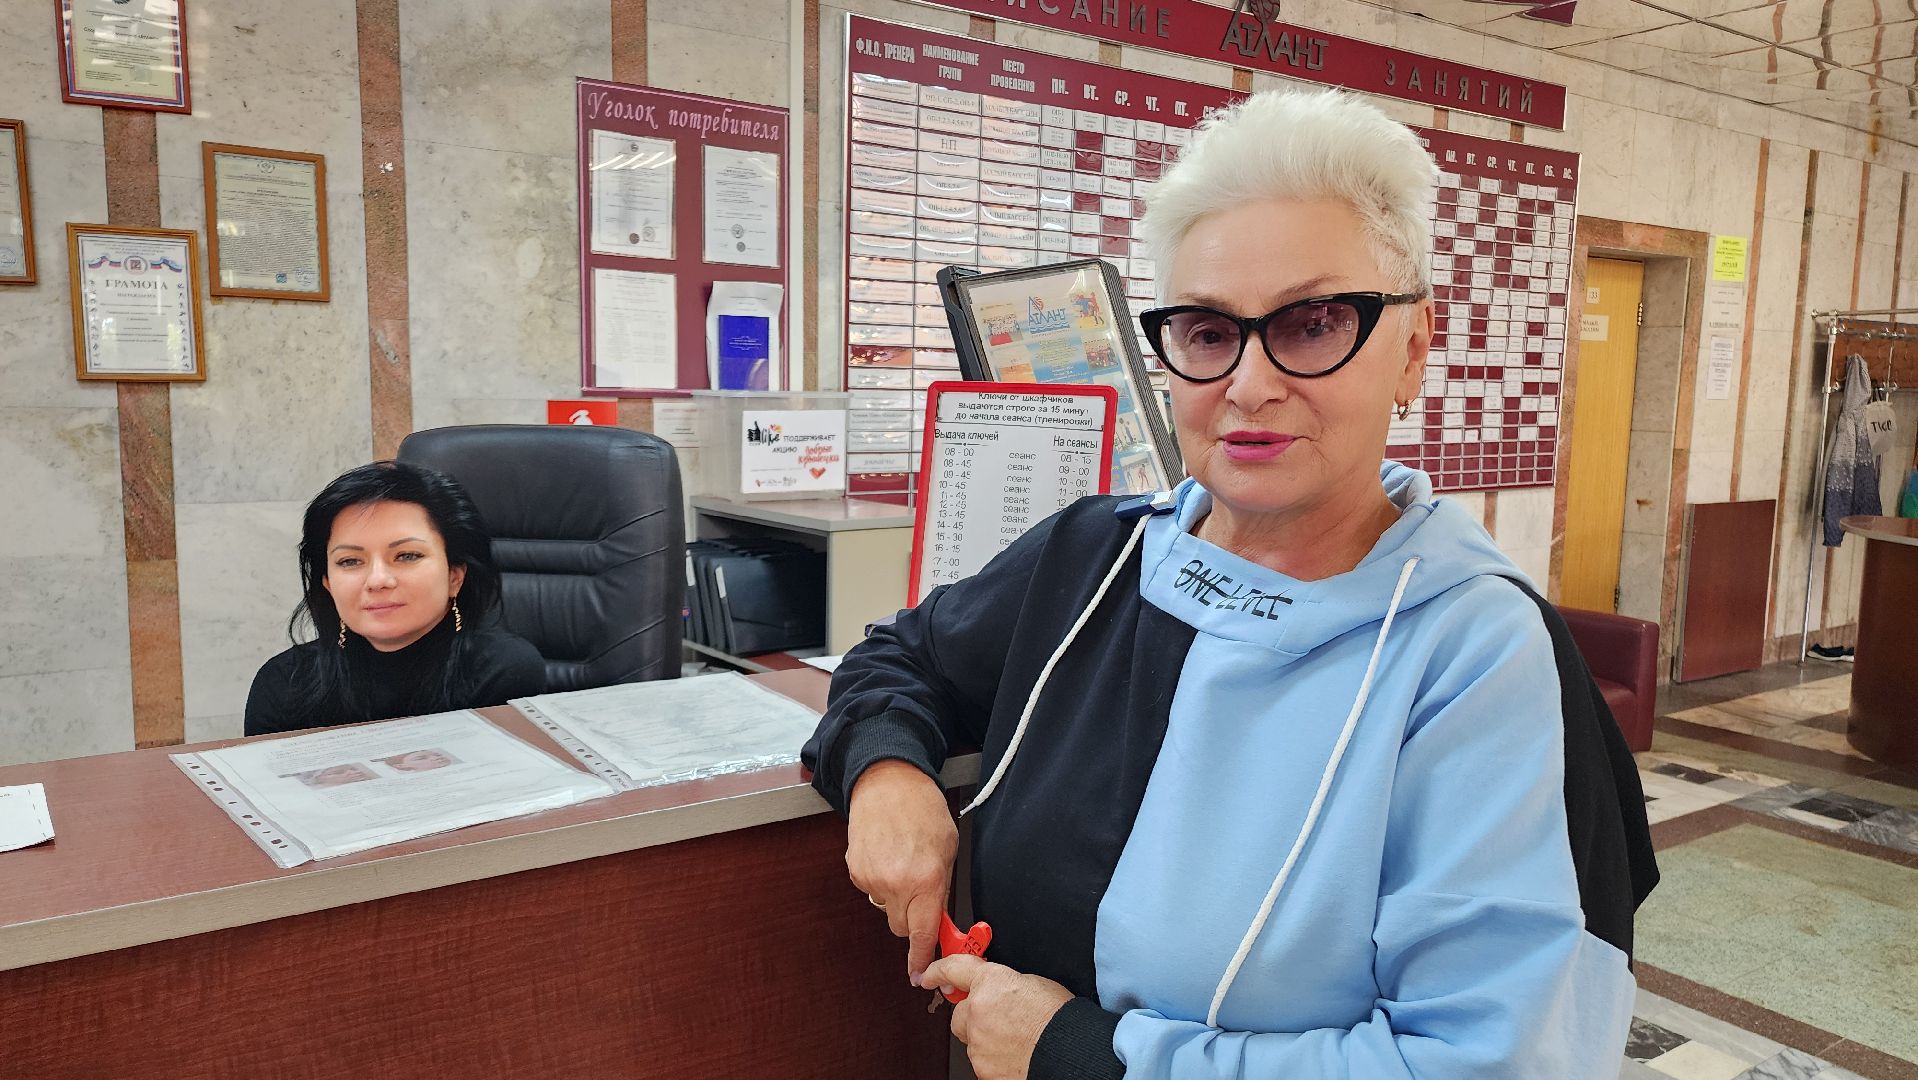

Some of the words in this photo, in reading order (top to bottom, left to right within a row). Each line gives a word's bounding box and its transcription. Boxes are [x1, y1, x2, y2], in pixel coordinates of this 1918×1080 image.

[855, 38, 882, 57] Ф.И.О.
[884, 43, 916, 63] ТРЕНЕРА
[922, 43, 980, 66] НАИМЕНОВАНИЕ
[1002, 58, 1025, 75] МЕСТО
[1220, 16, 1330, 70] АТЛАНТ
[1384, 59, 1533, 114] ЗАНЯТИЙ
[938, 64, 963, 81] ГРУПП
[990, 73, 1036, 93] ПРОВЕДЕНИЯ
[1051, 78, 1069, 95] ПН.
[1083, 83, 1099, 100] ВТ.
[1114, 90, 1131, 107] СР.
[1145, 95, 1160, 111] ЧТ.
[1174, 100, 1189, 117] ПТ.
[588, 92, 659, 130] Уголок
[668, 108, 780, 140] потребителя
[1466, 153, 1476, 165] ВТ.
[1487, 156, 1497, 168] СР.
[1507, 159, 1517, 171] ЧТ.
[1544, 165, 1555, 177] СБ.
[105, 279, 168, 291] ГРАМОТА
[978, 392, 1007, 401] Ключи
[1022, 393, 1074, 404] шкафчиков
[958, 402, 1004, 411] выдаются
[1006, 404, 1036, 413] строго
[955, 413, 967, 421] до
[1035, 415, 1093, 427] (тренировки)
[783, 434, 836, 442] ПОДДЕРЖИВАЕТ
[935, 429, 966, 440] Выдача
[967, 431, 999, 442] ключей
[1053, 435, 1064, 447] На
[1068, 438, 1098, 449] сеансы
[772, 446, 798, 454] АКЦИЮ
[945, 448, 955, 456] 08
[965, 448, 974, 456] 00
[1060, 454, 1071, 462] 08
[1082, 456, 1091, 464] 15
[961, 460, 971, 468] 45
[1059, 466, 1069, 474] 09
[1079, 468, 1089, 476] 00
[1059, 478, 1067, 486] 10
[955, 482, 966, 490] 45
[1004, 486, 1030, 494] сеанс
[1076, 490, 1087, 498] 00
[956, 492, 966, 500] 45
[939, 510, 947, 518] 13
[955, 511, 965, 519] 45
[953, 522, 964, 530] 45
[949, 558, 959, 566] 00
[932, 570, 941, 578] 17
[949, 571, 959, 579] 45
[1174, 560, 1233, 606] ONE
